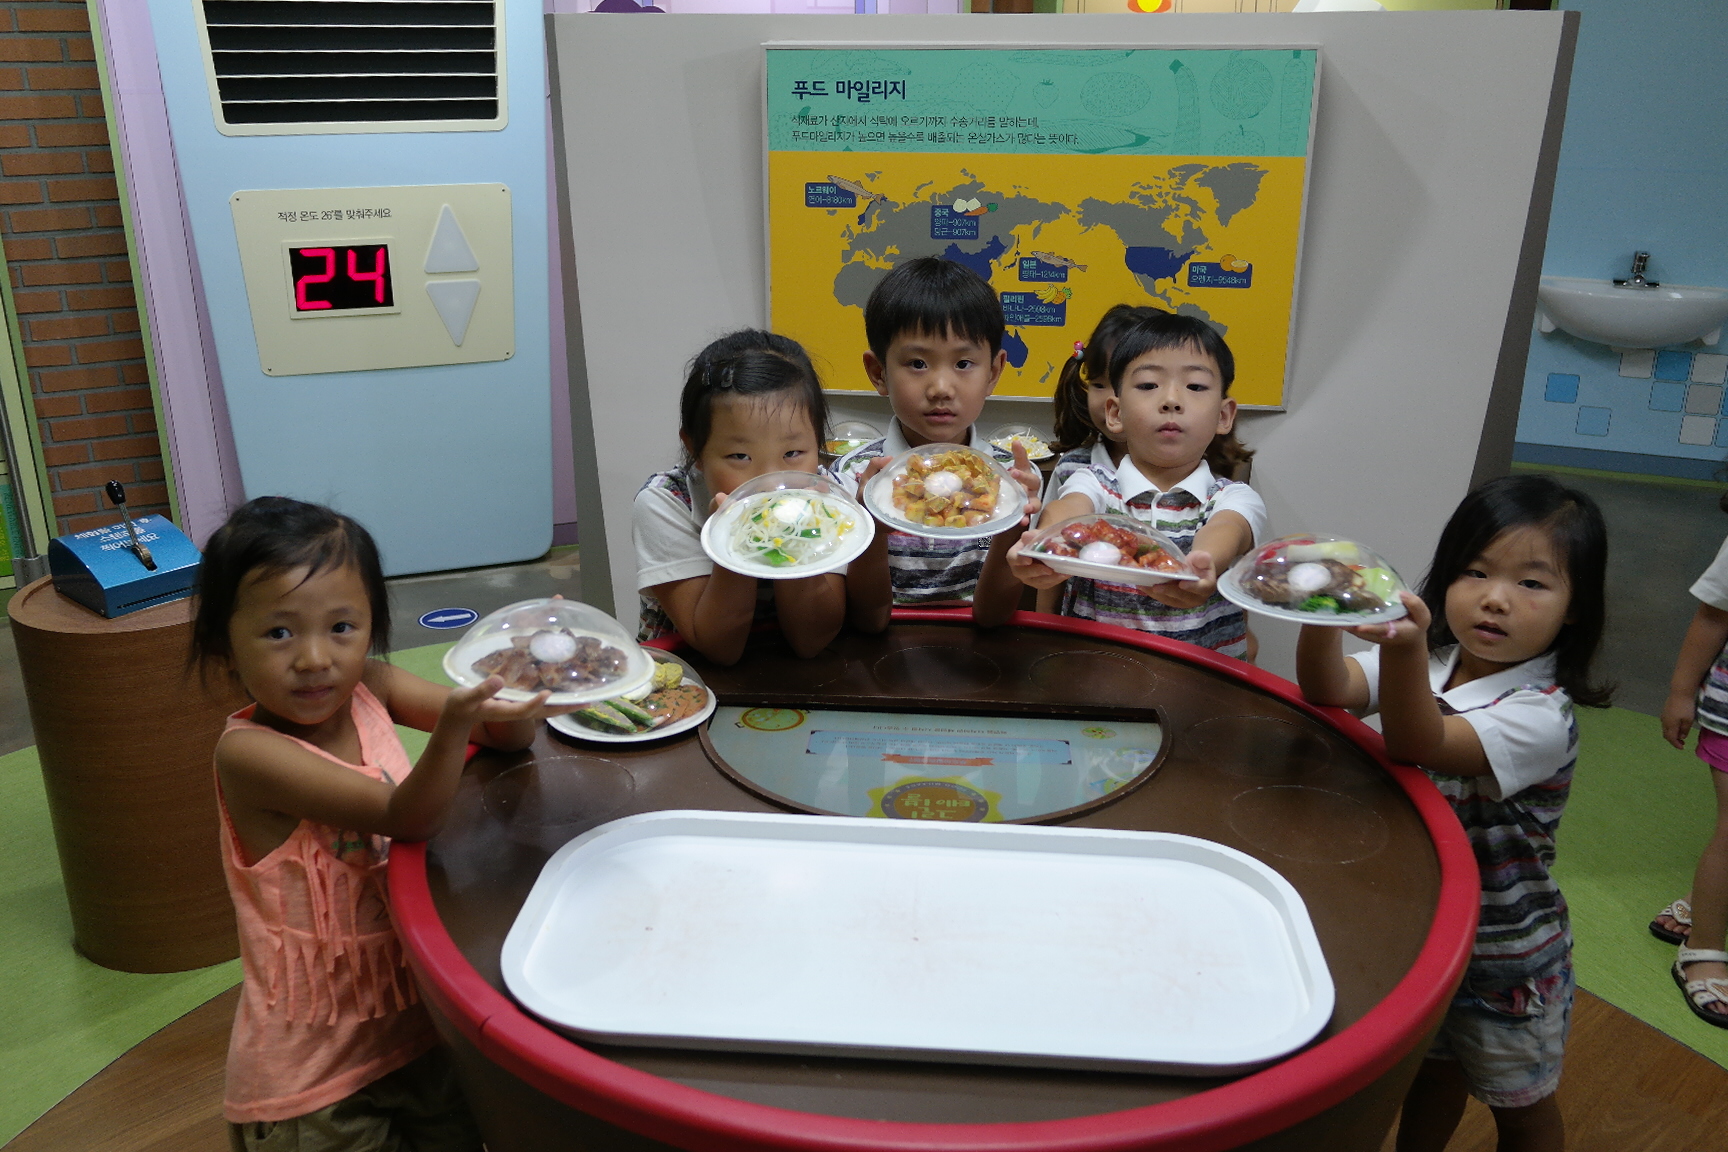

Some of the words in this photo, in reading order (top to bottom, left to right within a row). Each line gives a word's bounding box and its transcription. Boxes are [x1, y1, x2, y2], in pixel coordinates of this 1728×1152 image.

[791, 80, 829, 100] 푸드
[835, 79, 907, 103] 마일리지
[791, 115, 828, 126] 식재료가
[870, 115, 898, 126] 식탁에
[900, 115, 947, 127] 오르기까지
[950, 116, 996, 128] 수송거리를
[792, 130, 855, 142] 푸드마일리지가
[858, 131, 885, 142] 높으면
[927, 131, 965, 143] 배출되는
[967, 132, 1015, 144] 온실가스가
[1017, 132, 1046, 145] 많다는
[808, 186, 837, 194] 노르웨이
[277, 211, 297, 222] 적정
[299, 210, 319, 221] 온도
[346, 208, 392, 220] 맞춰주세요
[934, 208, 949, 217] 중국
[1022, 260, 1037, 269] 일본
[1192, 265, 1207, 274] 미국
[296, 247, 385, 310] 24
[1002, 294, 1025, 304] 필리핀
[901, 793, 971, 807] 테이블
[911, 806, 957, 819] 그린
